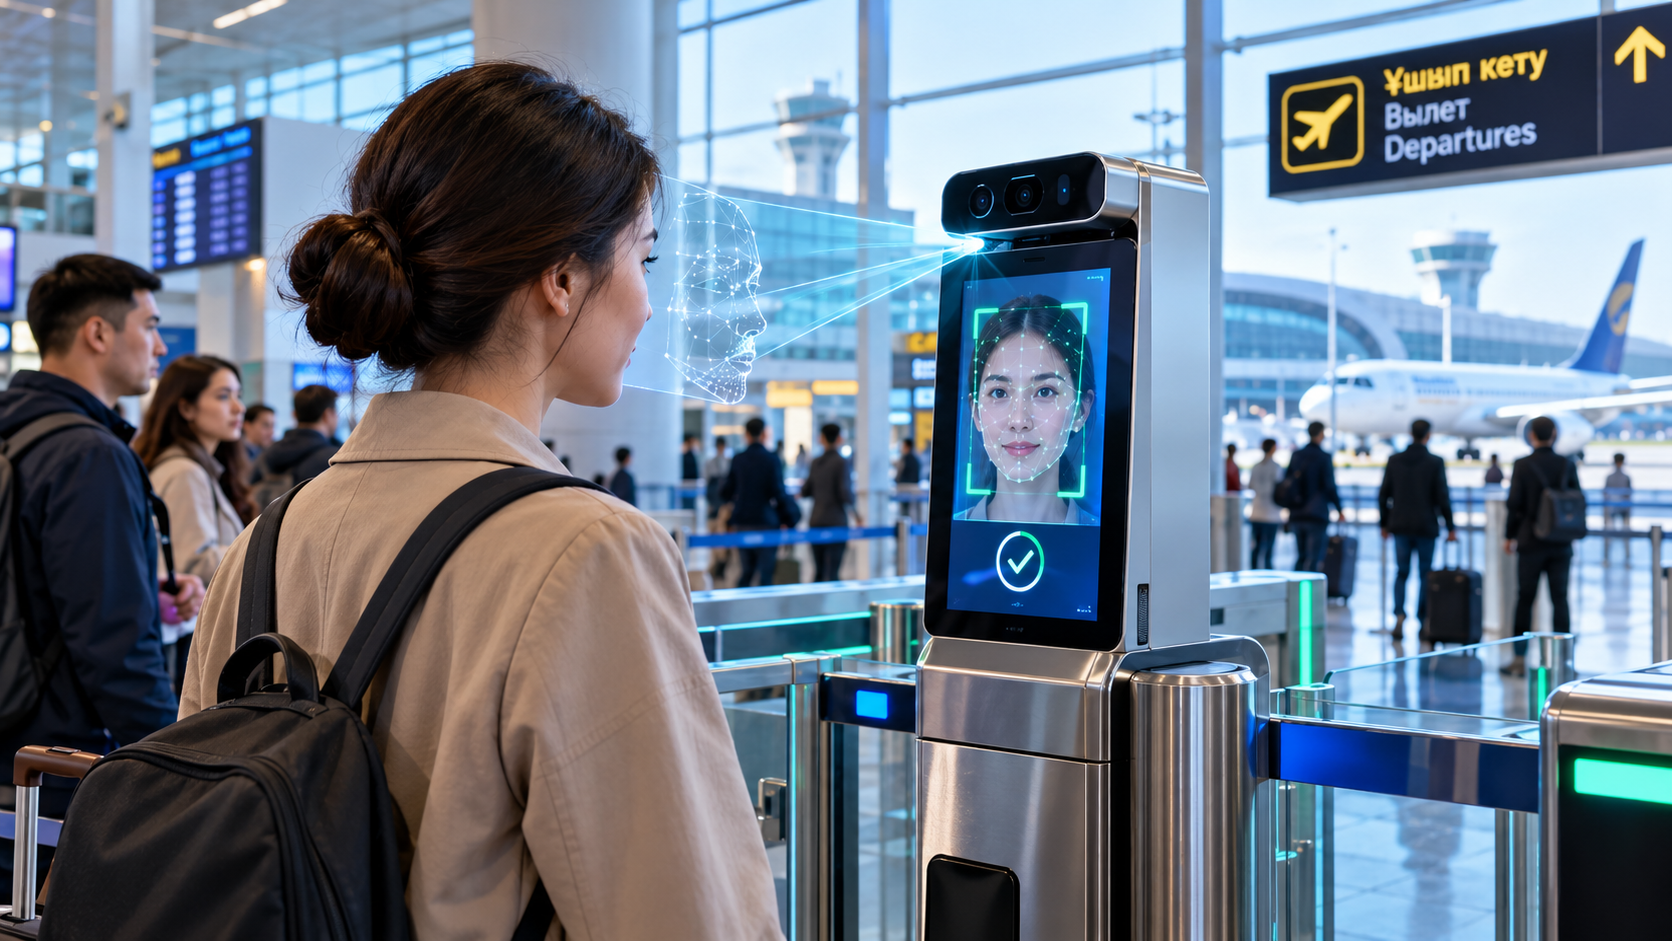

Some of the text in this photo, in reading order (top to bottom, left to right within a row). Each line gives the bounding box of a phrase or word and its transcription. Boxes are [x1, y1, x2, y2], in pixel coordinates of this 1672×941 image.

[1479, 48, 1549, 82] кету
[1384, 97, 1471, 131] Вылет
[1384, 121, 1538, 165] Departures
